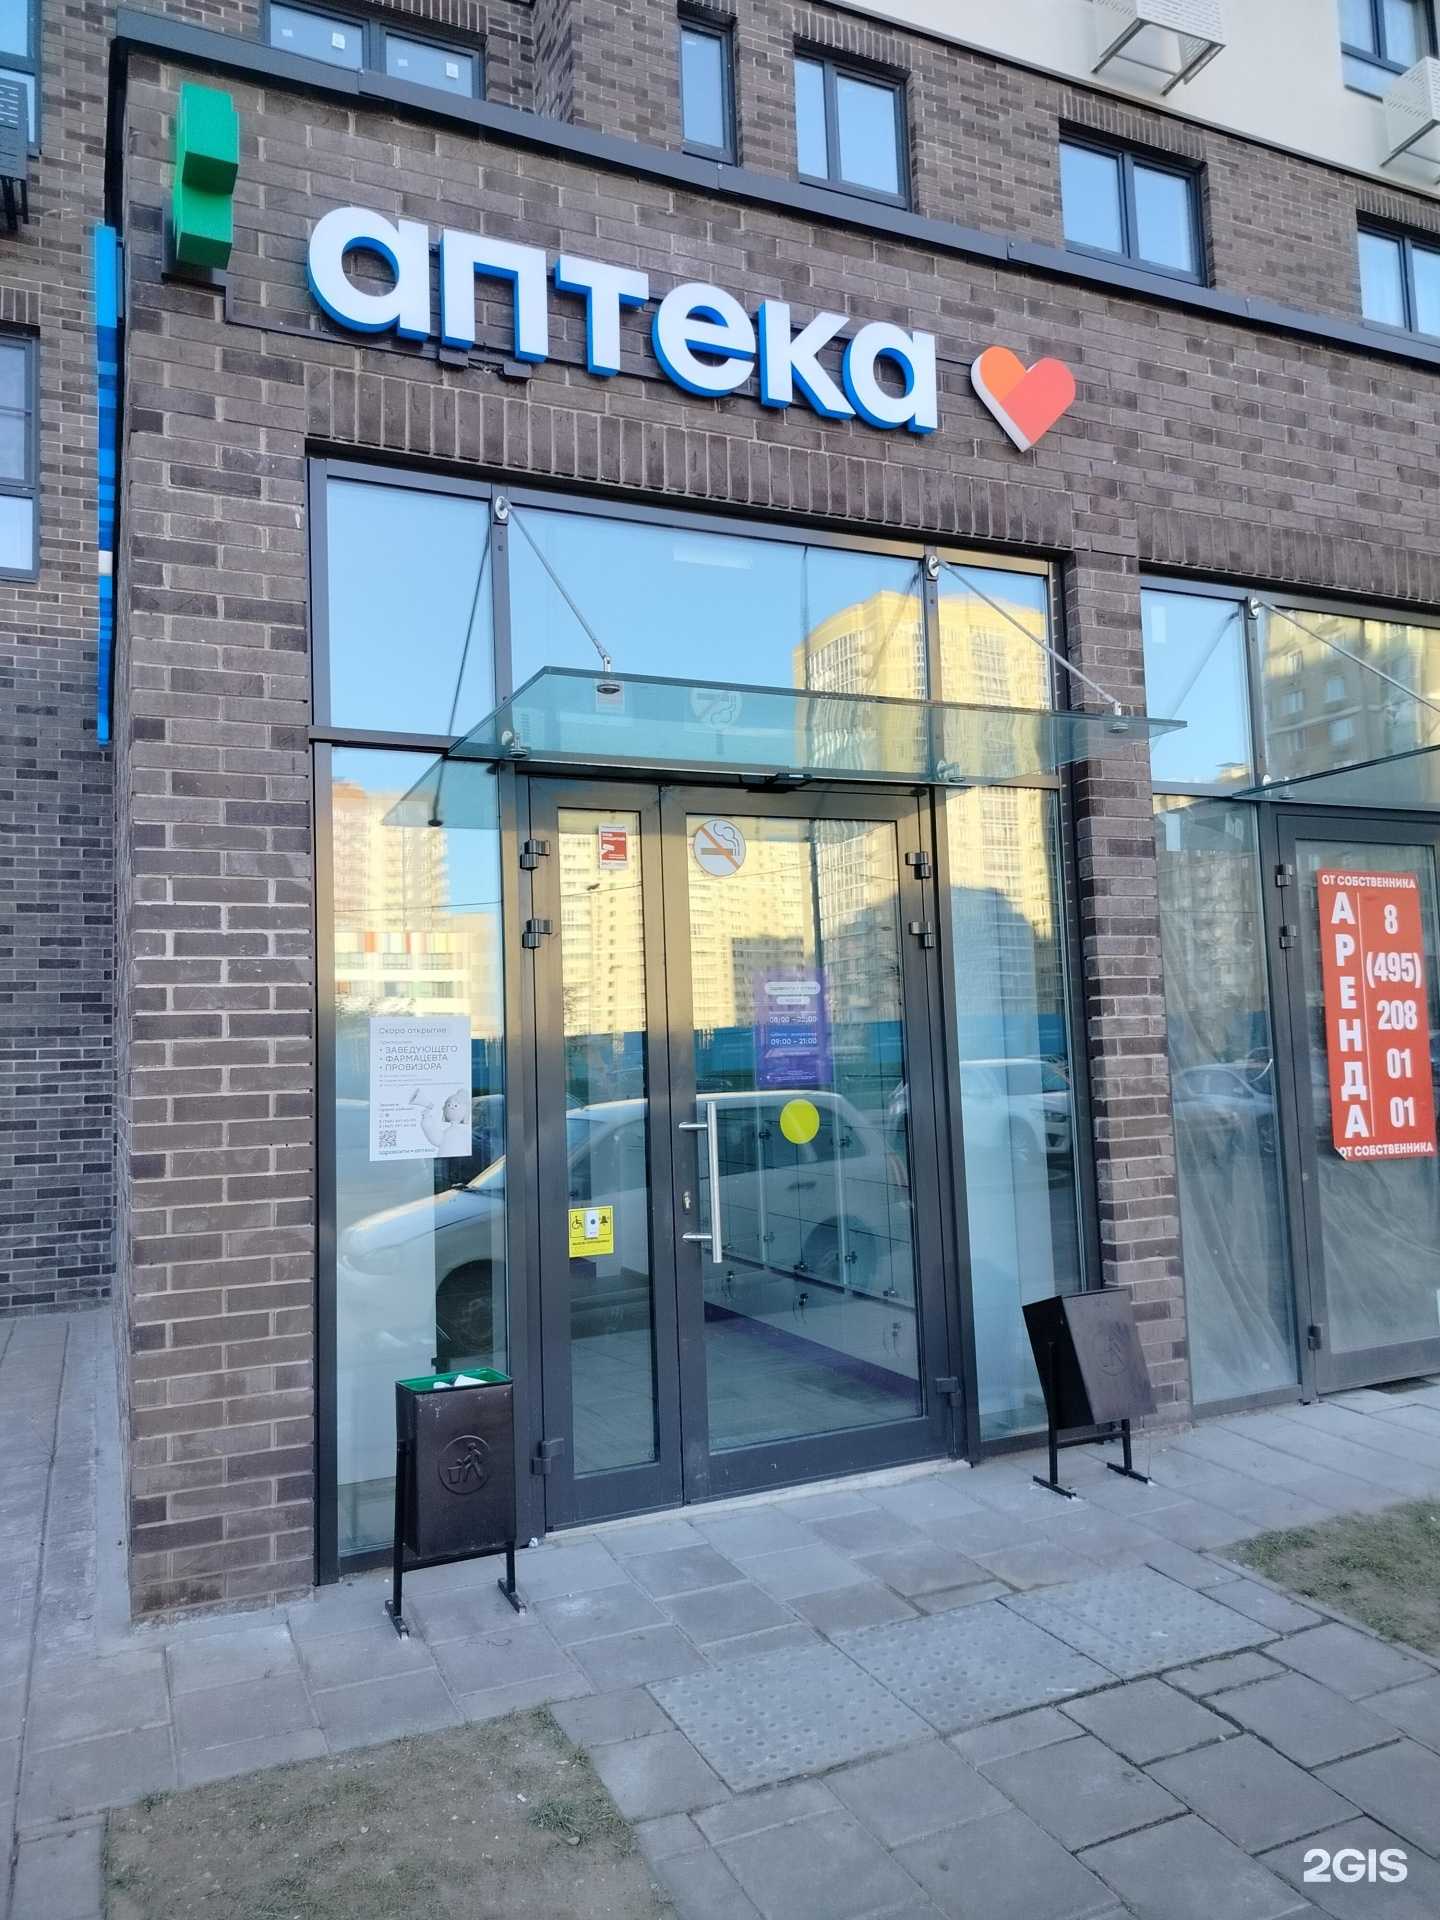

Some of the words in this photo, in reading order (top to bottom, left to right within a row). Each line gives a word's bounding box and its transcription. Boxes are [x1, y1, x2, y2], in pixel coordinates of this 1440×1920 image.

[307, 206, 938, 435] аптека
[1322, 875, 1336, 885] ОТ
[1337, 875, 1416, 889] СОБСТВЕННИКА
[1383, 904, 1398, 935] 8
[1366, 951, 1422, 988] (495)
[1331, 892, 1370, 1139] АРЕНДА
[1377, 1000, 1418, 1031] 208
[385, 1045, 458, 1054] ЗАВЕДУЮЩЕГО
[385, 1053, 448, 1063] ФАРМАЦЕВТА
[1386, 1048, 1413, 1080] 01
[385, 1062, 442, 1071] ПРОВИЗОРА
[1390, 1096, 1416, 1129] 01
[1354, 1141, 1434, 1157] СОБСТВЕННИКА
